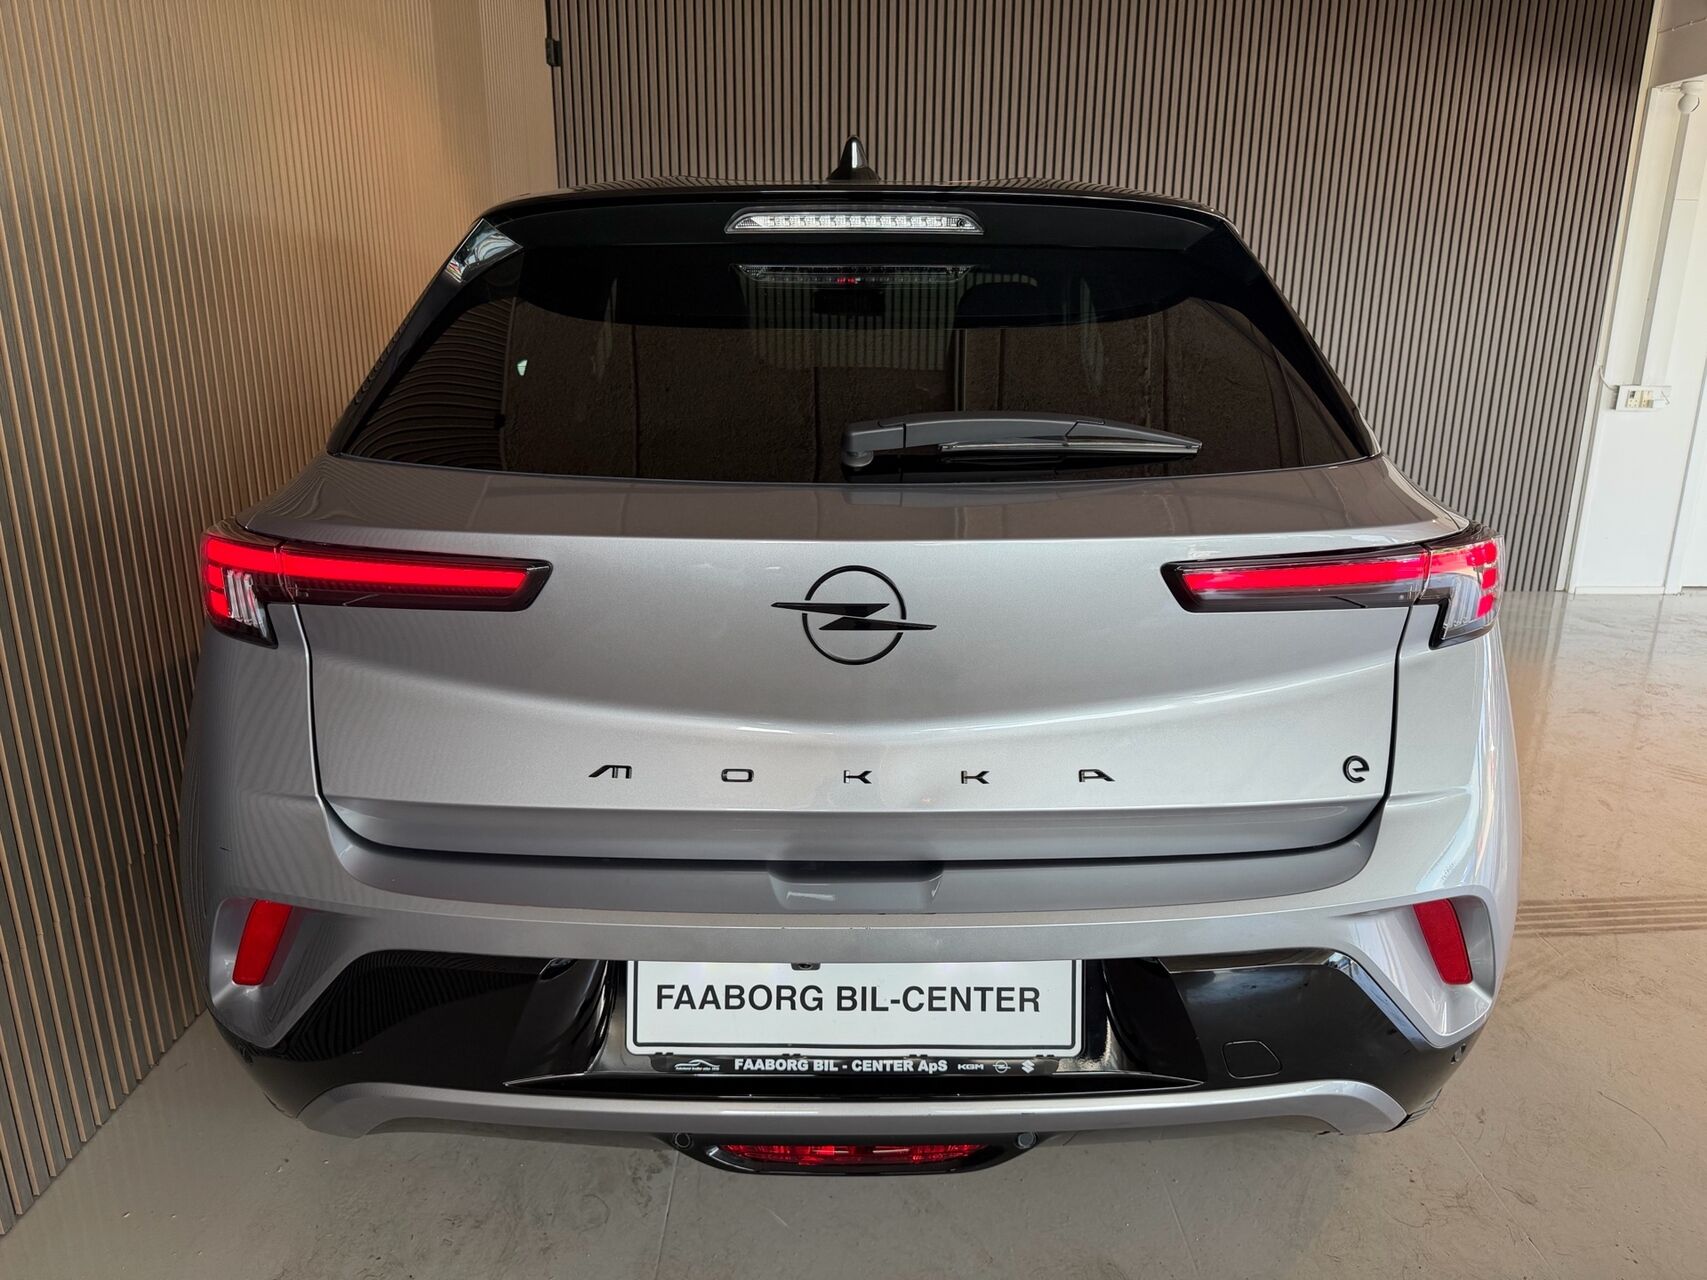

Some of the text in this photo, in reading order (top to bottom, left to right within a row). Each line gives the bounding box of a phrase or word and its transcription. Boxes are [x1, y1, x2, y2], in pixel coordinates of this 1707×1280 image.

[588, 764, 1115, 785] MOKKA
[1342, 755, 1370, 784] e
[656, 984, 1042, 1014] FAABORG BIL-CENTER
[734, 1058, 809, 1072] FAABORG
[813, 1059, 839, 1072] BIL
[851, 1059, 914, 1073] CENTER
[917, 1059, 948, 1075] ApS
[957, 1063, 985, 1071] KGM
